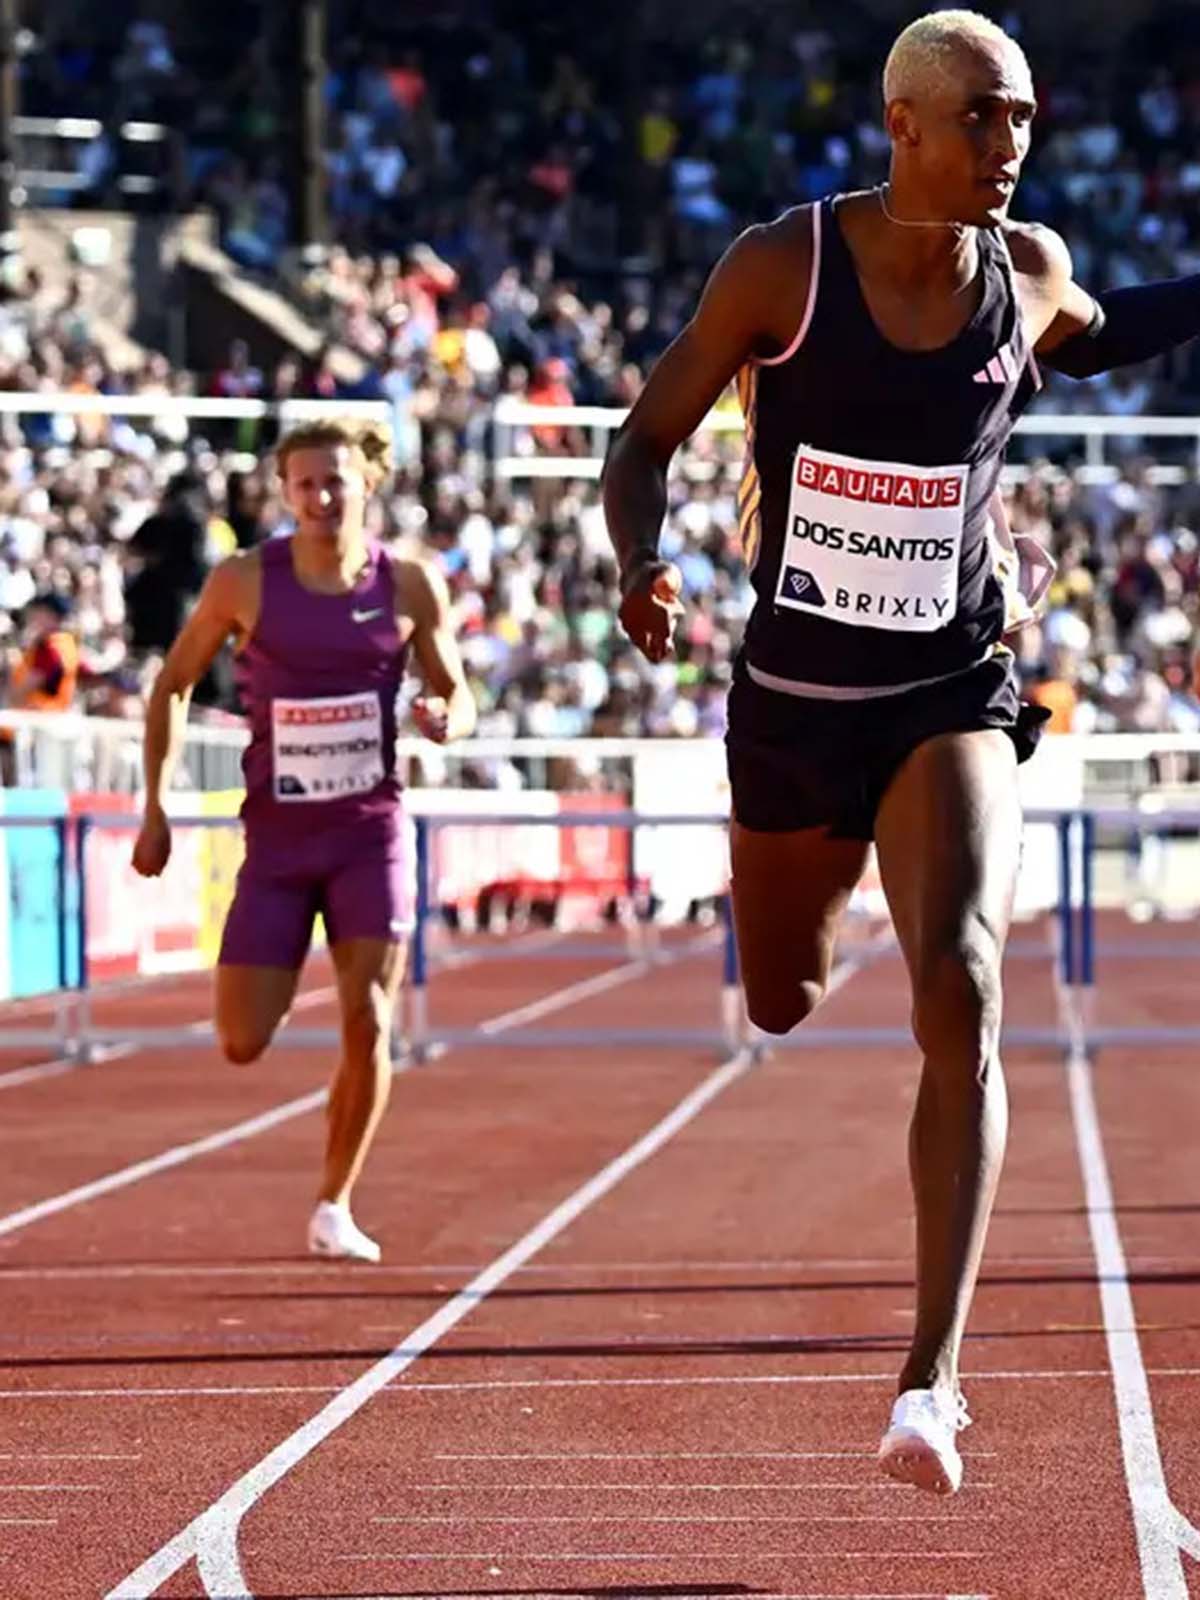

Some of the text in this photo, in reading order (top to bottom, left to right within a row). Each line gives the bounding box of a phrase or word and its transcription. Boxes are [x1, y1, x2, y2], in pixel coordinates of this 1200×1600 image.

[800, 462, 957, 503] BAUHAUS
[792, 515, 954, 561] DOS SANTOS
[834, 588, 949, 618] BRIXLY
